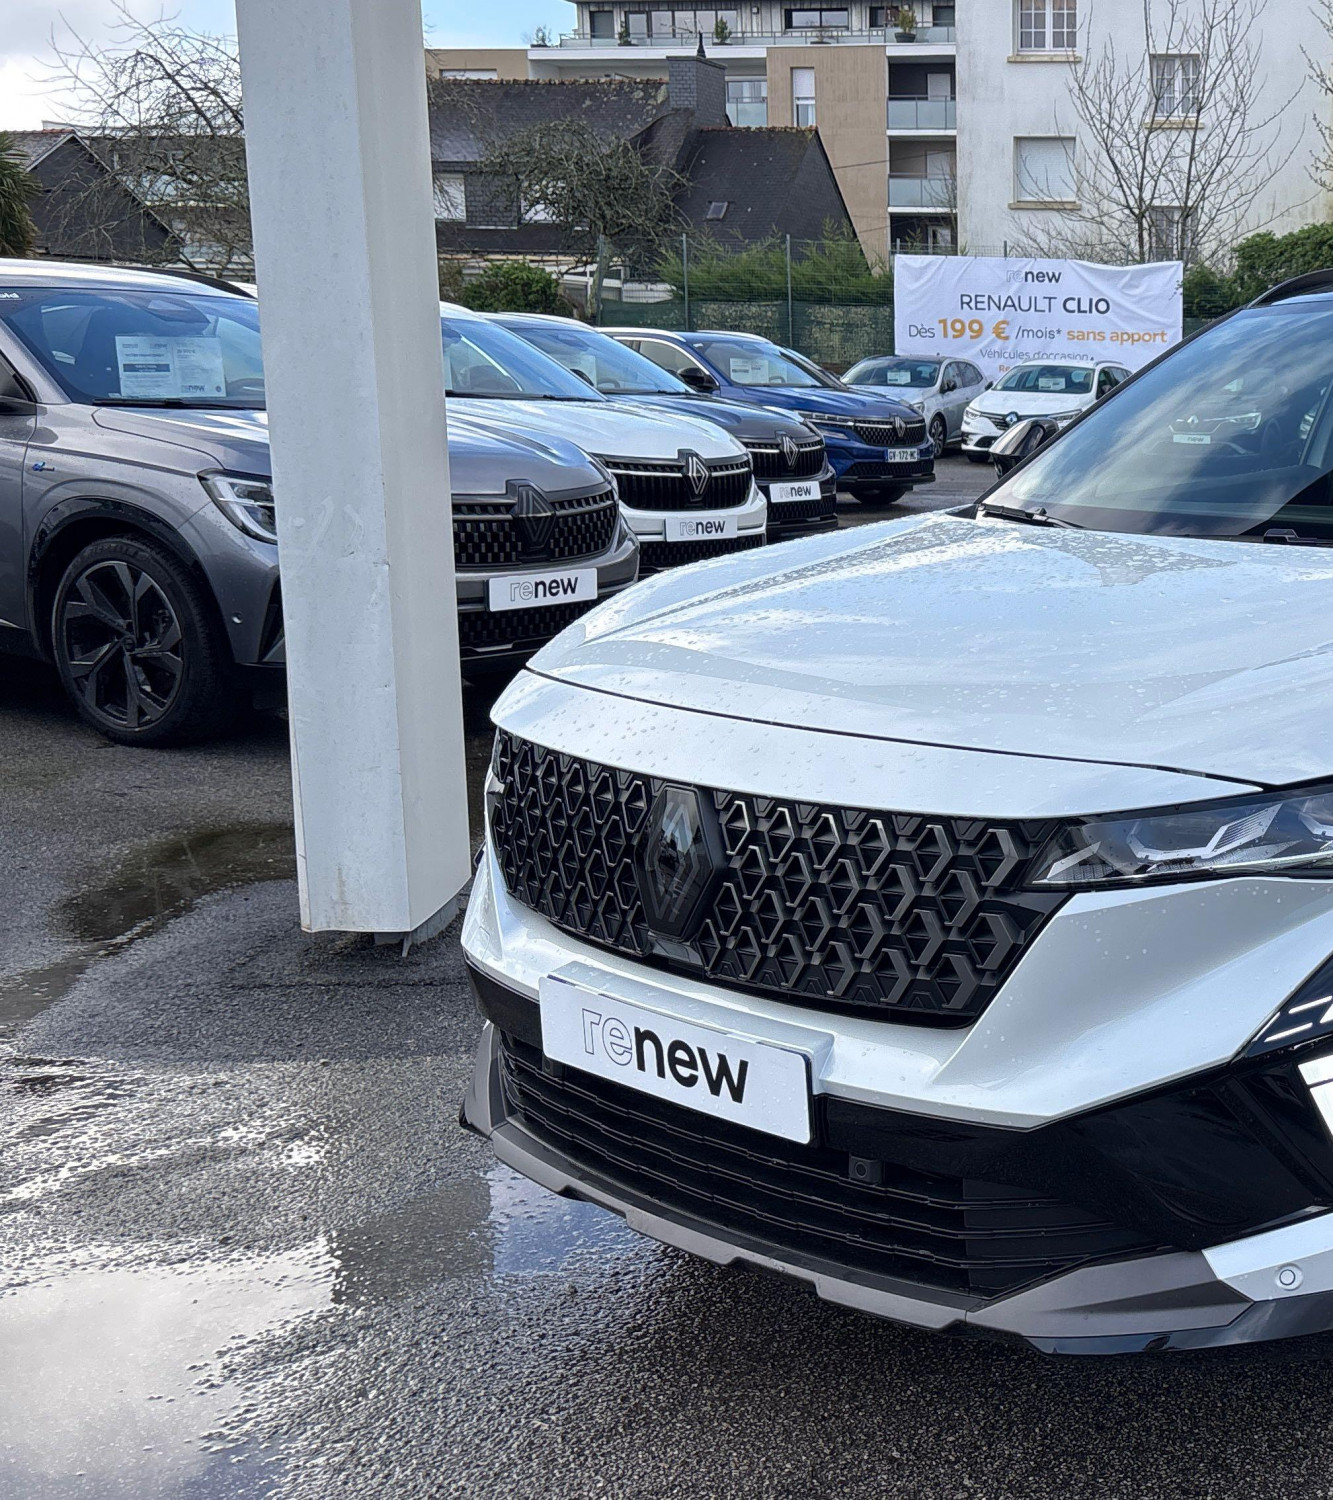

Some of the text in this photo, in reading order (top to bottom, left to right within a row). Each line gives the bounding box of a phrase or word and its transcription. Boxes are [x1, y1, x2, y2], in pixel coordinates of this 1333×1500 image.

[1006, 270, 1062, 284] renew
[960, 294, 1111, 315] RENAULT CLIO
[908, 323, 936, 339] Dès
[938, 318, 984, 340] 199
[992, 320, 1010, 341] €
[1066, 330, 1105, 343] sans
[1109, 330, 1168, 347] apport
[980, 349, 1030, 359] Véhicules
[779, 484, 812, 499] renew
[680, 520, 726, 536] renew
[510, 577, 579, 602] renew
[581, 1007, 749, 1104] renew
